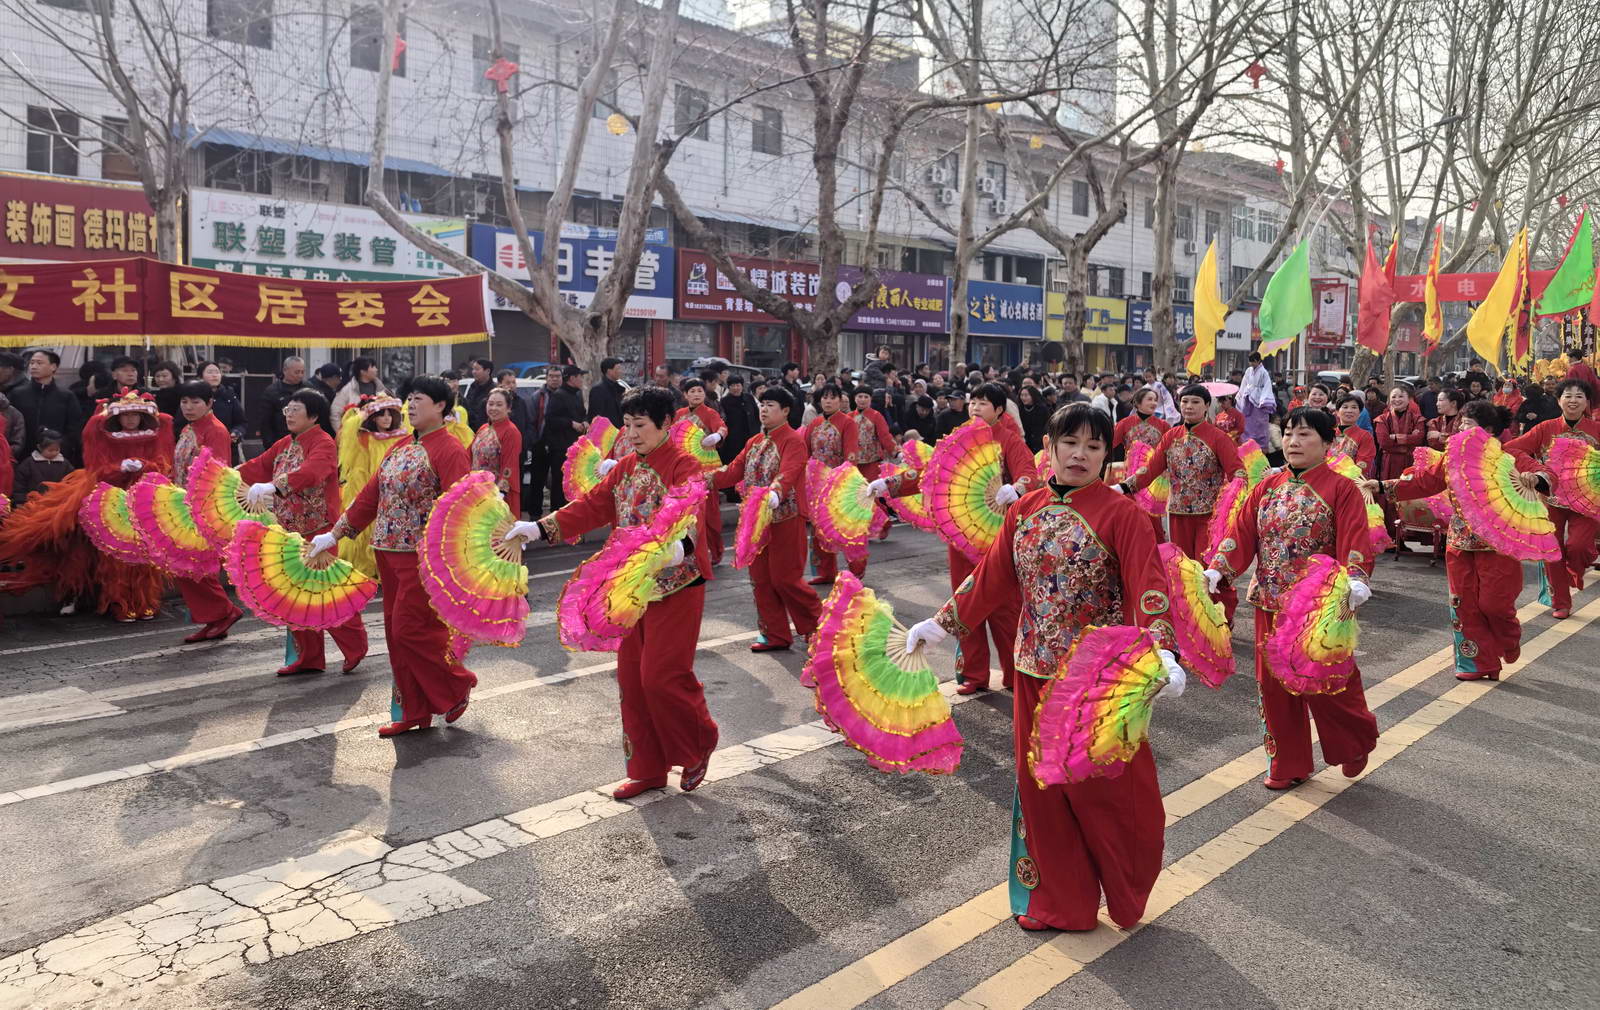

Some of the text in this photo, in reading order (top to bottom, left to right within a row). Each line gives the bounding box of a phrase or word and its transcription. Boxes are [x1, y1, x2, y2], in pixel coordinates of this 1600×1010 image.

[6, 200, 75, 248] 装饰画
[213, 221, 396, 266] 联塑家装管
